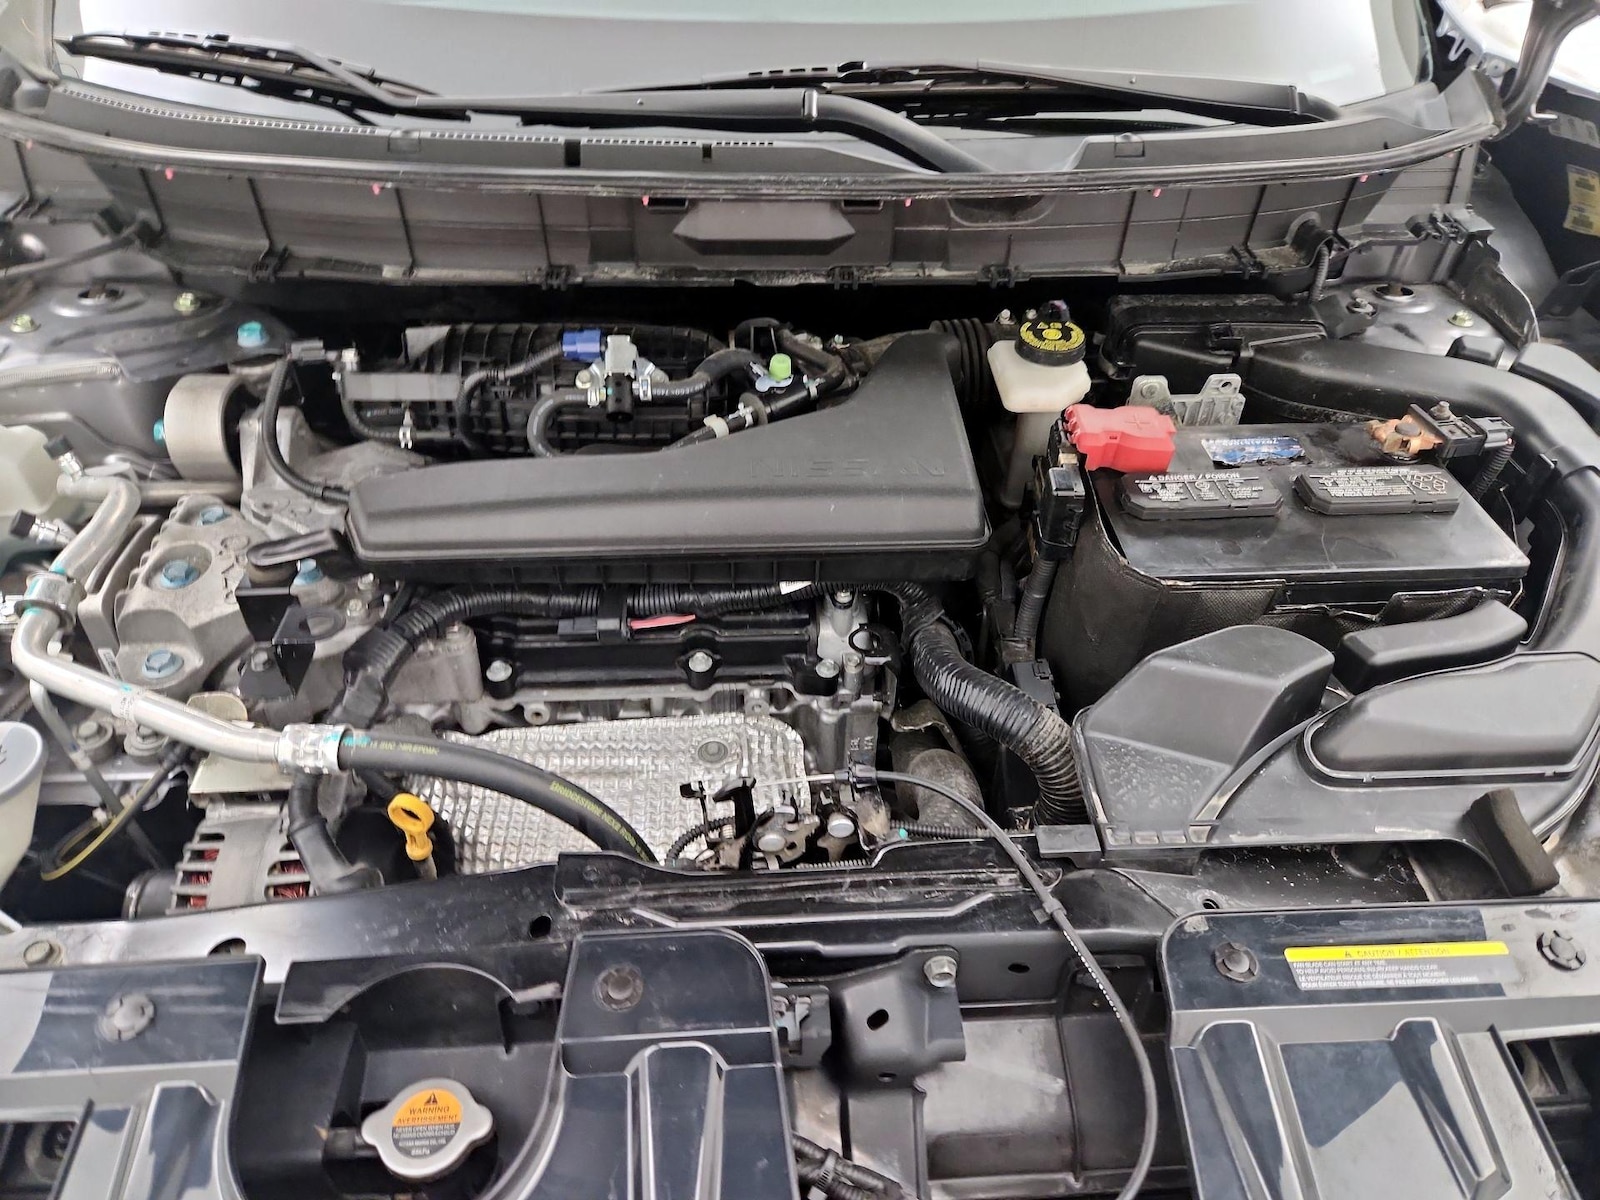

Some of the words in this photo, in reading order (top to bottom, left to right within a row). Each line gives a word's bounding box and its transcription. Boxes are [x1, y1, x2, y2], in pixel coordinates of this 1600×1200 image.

[750, 457, 945, 478] NISSAN
[1157, 473, 1196, 481] DANGER
[1205, 472, 1241, 480] POISON
[1357, 950, 1394, 958] CAUTION
[1404, 948, 1450, 956] ATTENTION
[409, 1105, 450, 1115] WARNING
[398, 1114, 458, 1124] AVERTISSEMENT
